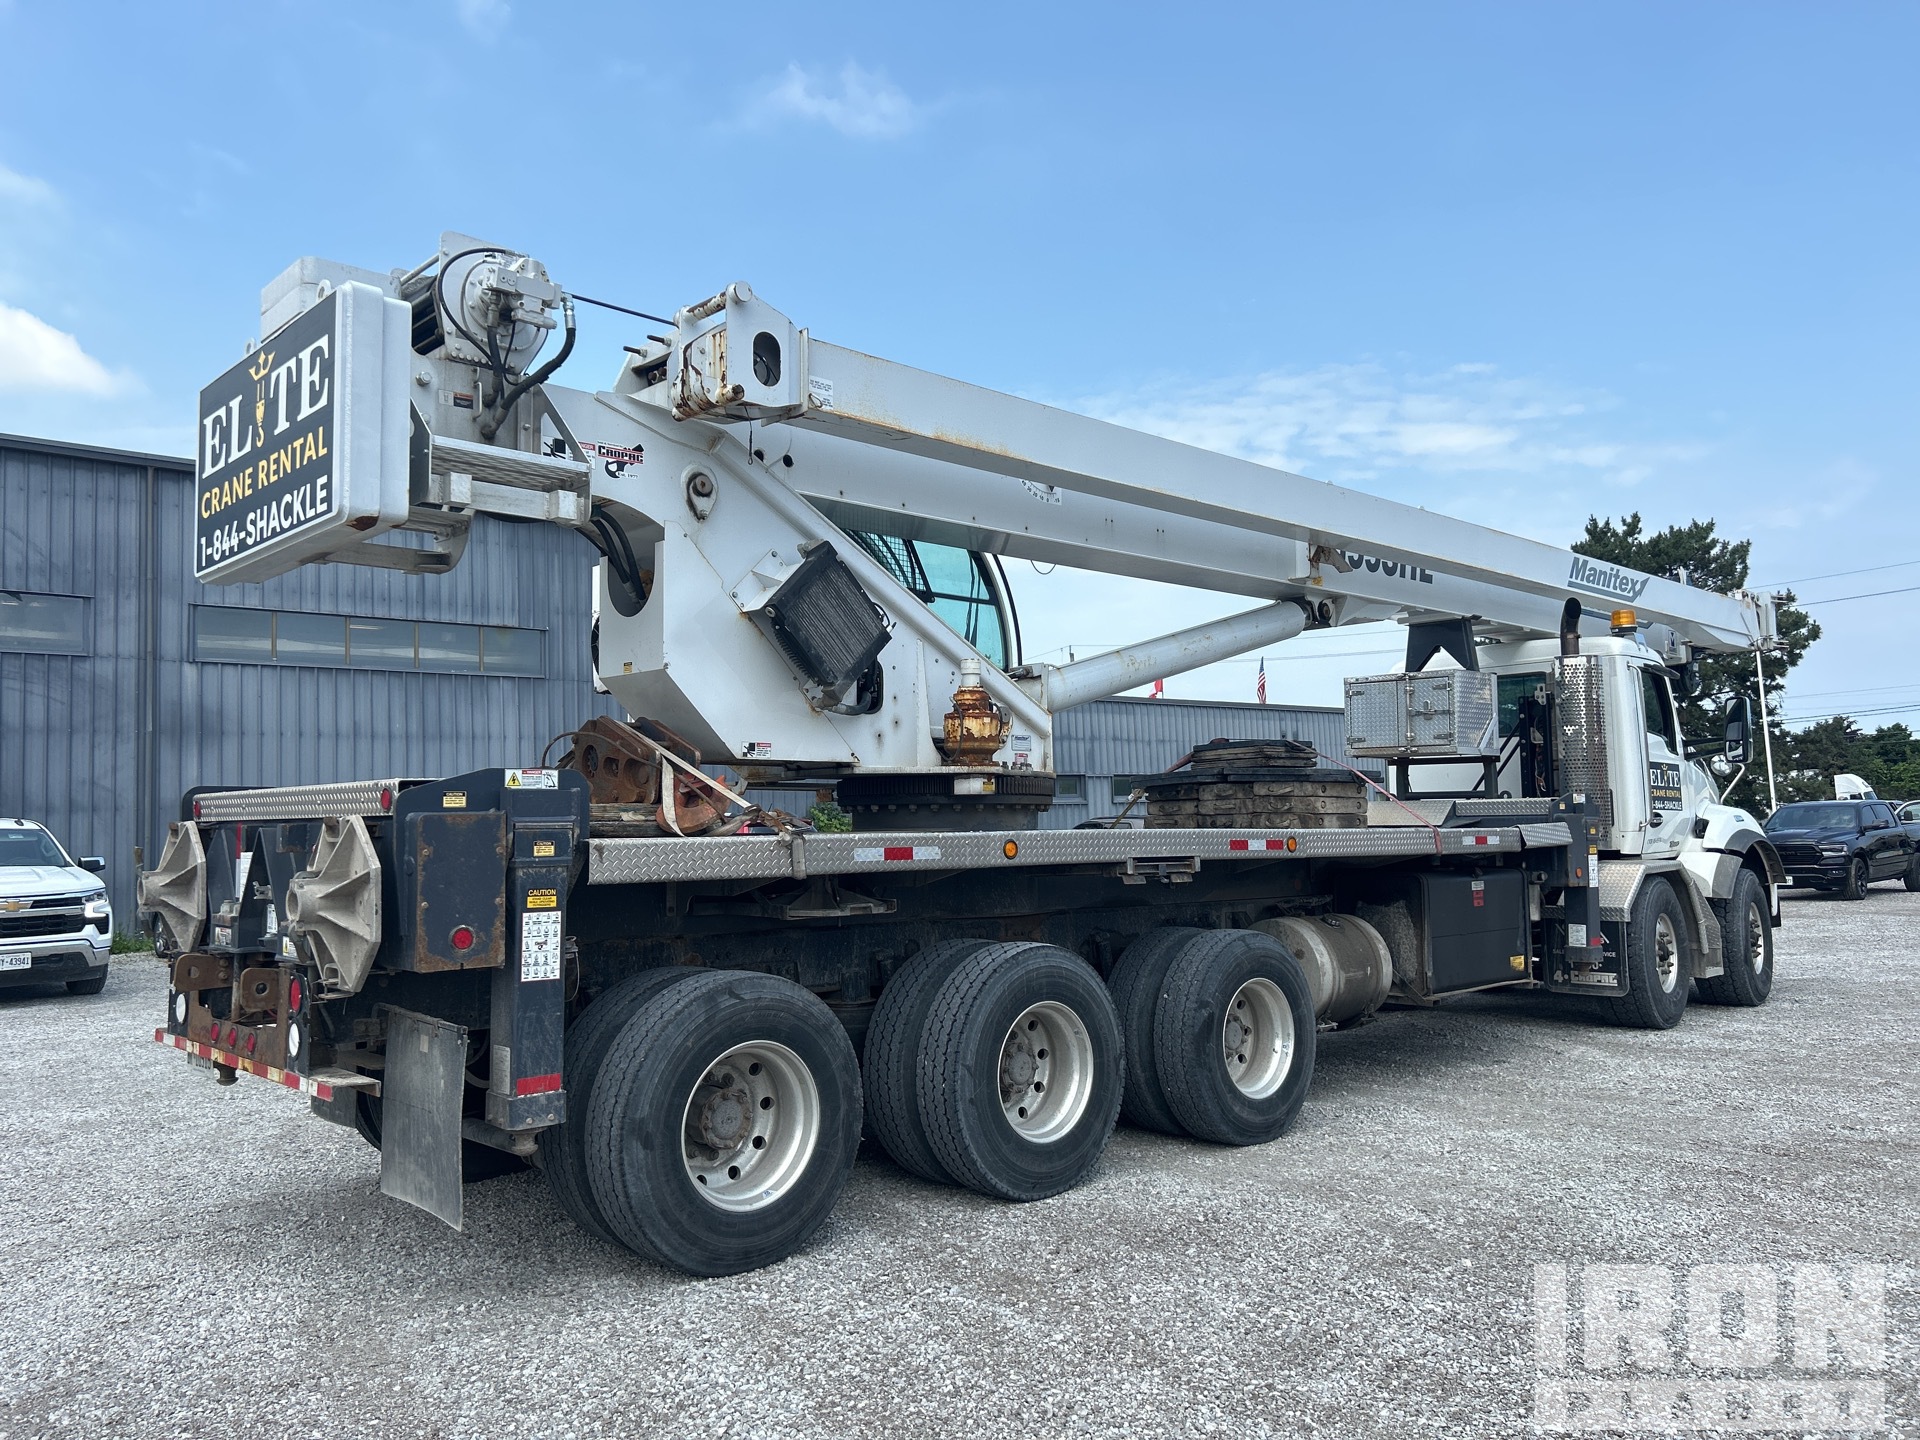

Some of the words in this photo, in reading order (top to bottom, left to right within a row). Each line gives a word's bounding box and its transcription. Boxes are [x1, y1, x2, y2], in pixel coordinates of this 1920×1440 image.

[201, 334, 329, 479] ELITE
[201, 467, 253, 519] CRANE
[258, 426, 328, 490] RENTAL
[200, 474, 328, 567] 1-844-SHACKLE
[1569, 556, 1640, 595] Manitex
[1649, 768, 1680, 788] ELITE
[1667, 789, 1682, 799] RENTAL
